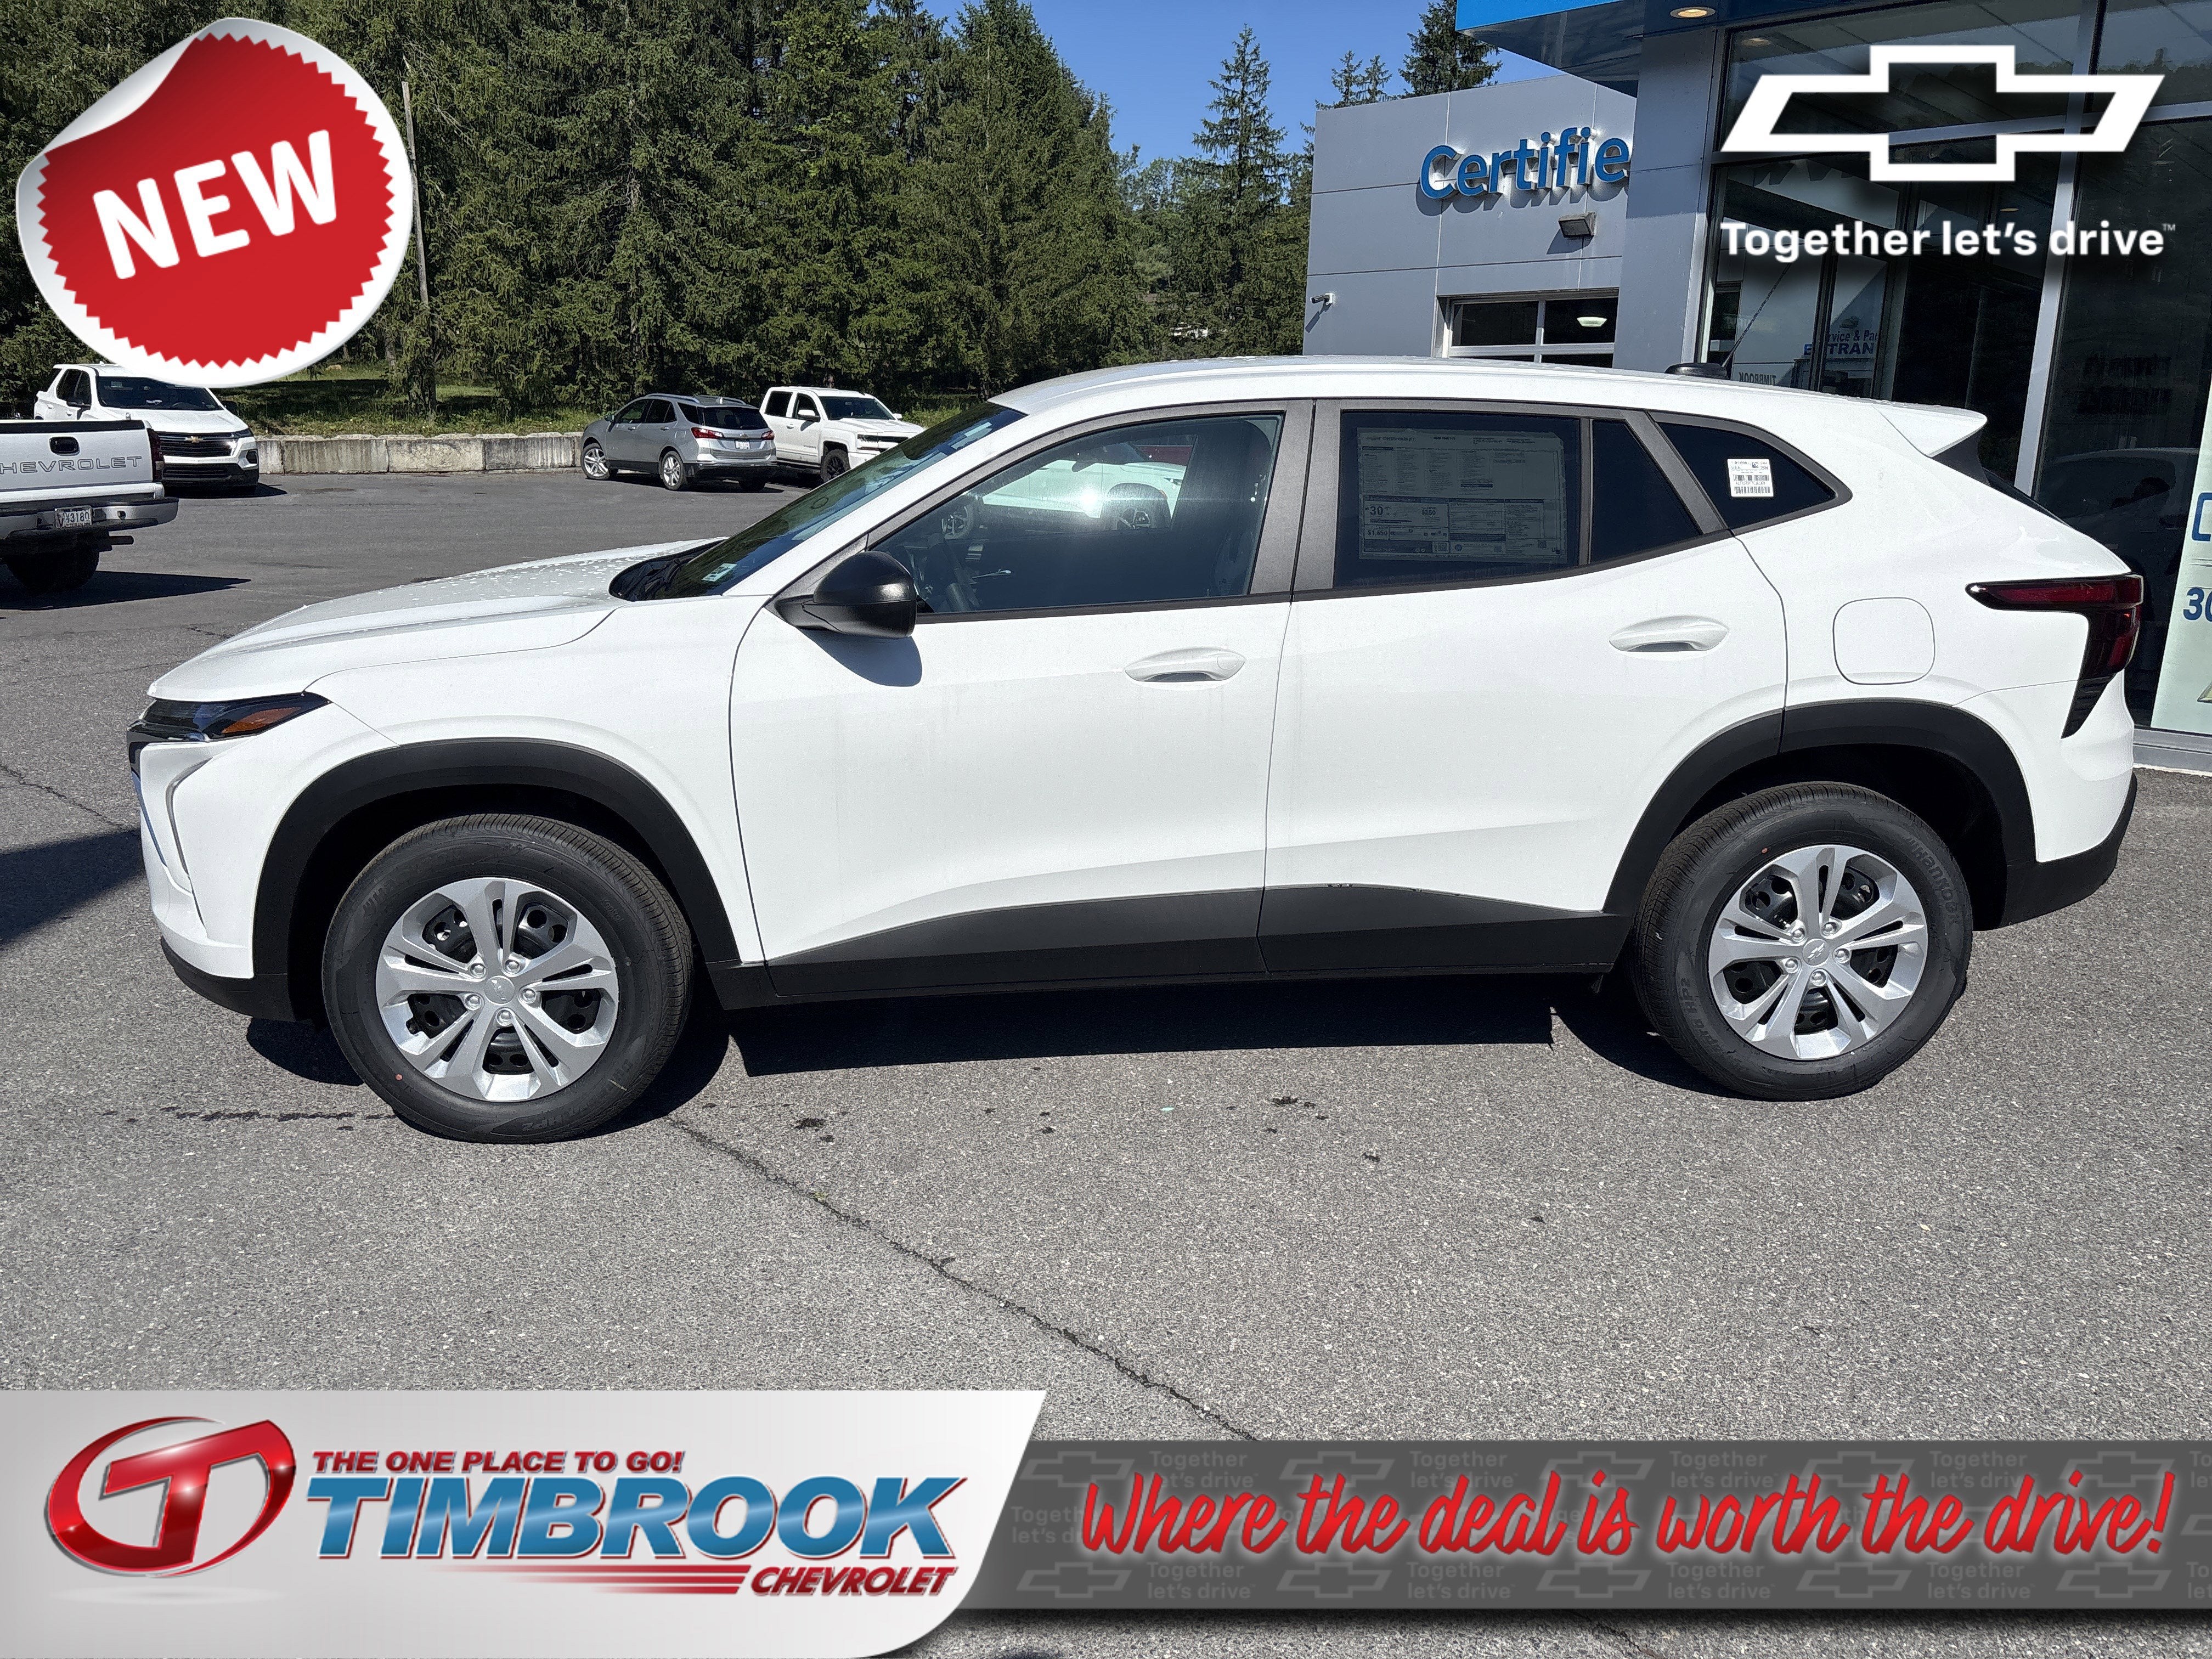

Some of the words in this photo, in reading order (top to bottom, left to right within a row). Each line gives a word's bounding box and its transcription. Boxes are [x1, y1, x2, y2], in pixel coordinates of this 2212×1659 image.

[1420, 127, 1629, 200] Certifie
[1828, 331, 1850, 342] rvice
[1804, 342, 1874, 356] ETRAN
[0, 456, 142, 475] HEVROLET
[1370, 506, 1384, 515] 30
